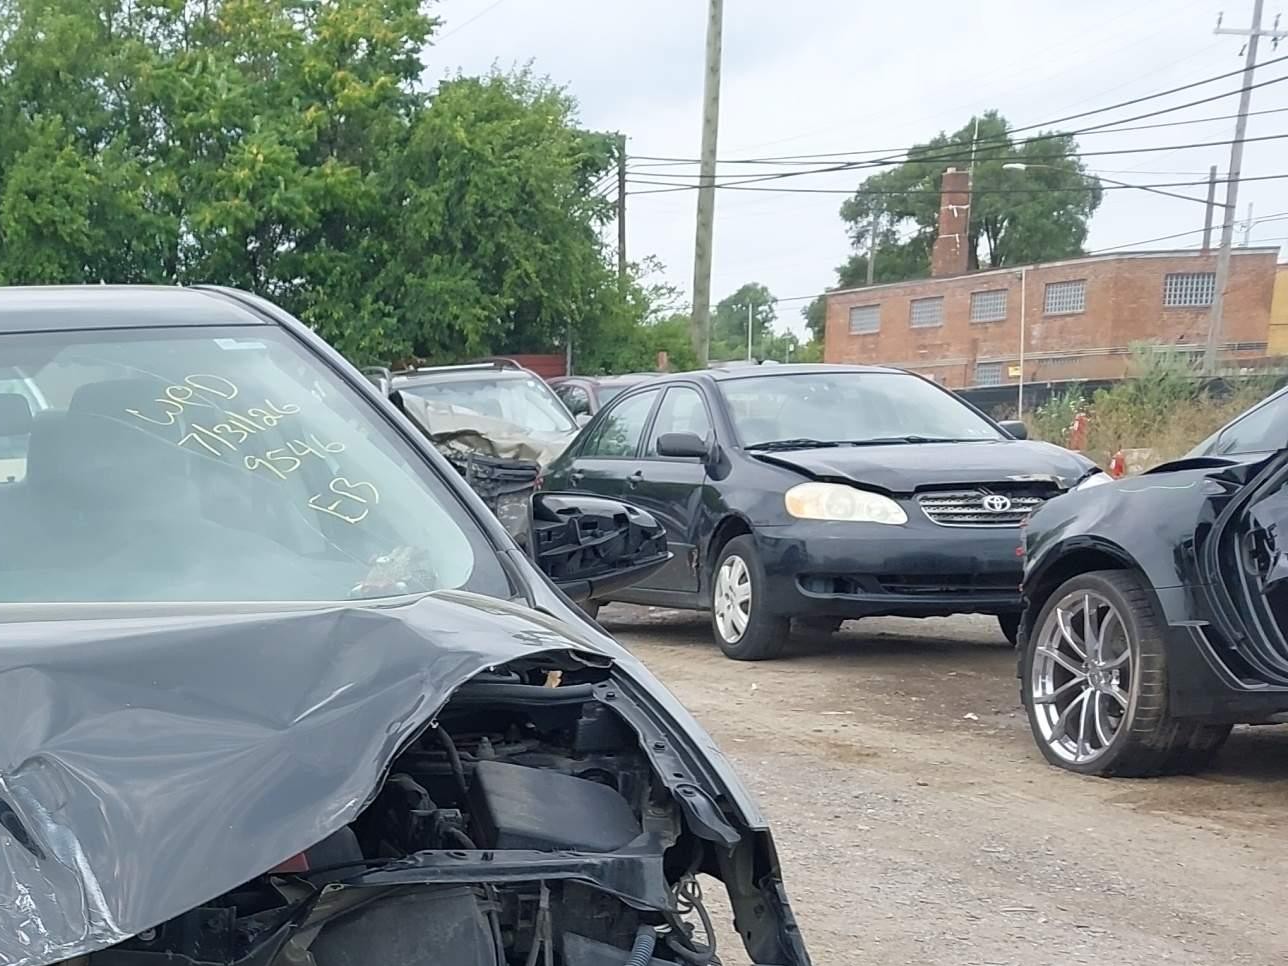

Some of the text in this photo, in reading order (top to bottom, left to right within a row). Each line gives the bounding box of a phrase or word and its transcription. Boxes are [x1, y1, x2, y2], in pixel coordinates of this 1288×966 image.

[178, 399, 301, 456] 7/31/26
[244, 434, 346, 480] 9546
[307, 477, 380, 524] EB
